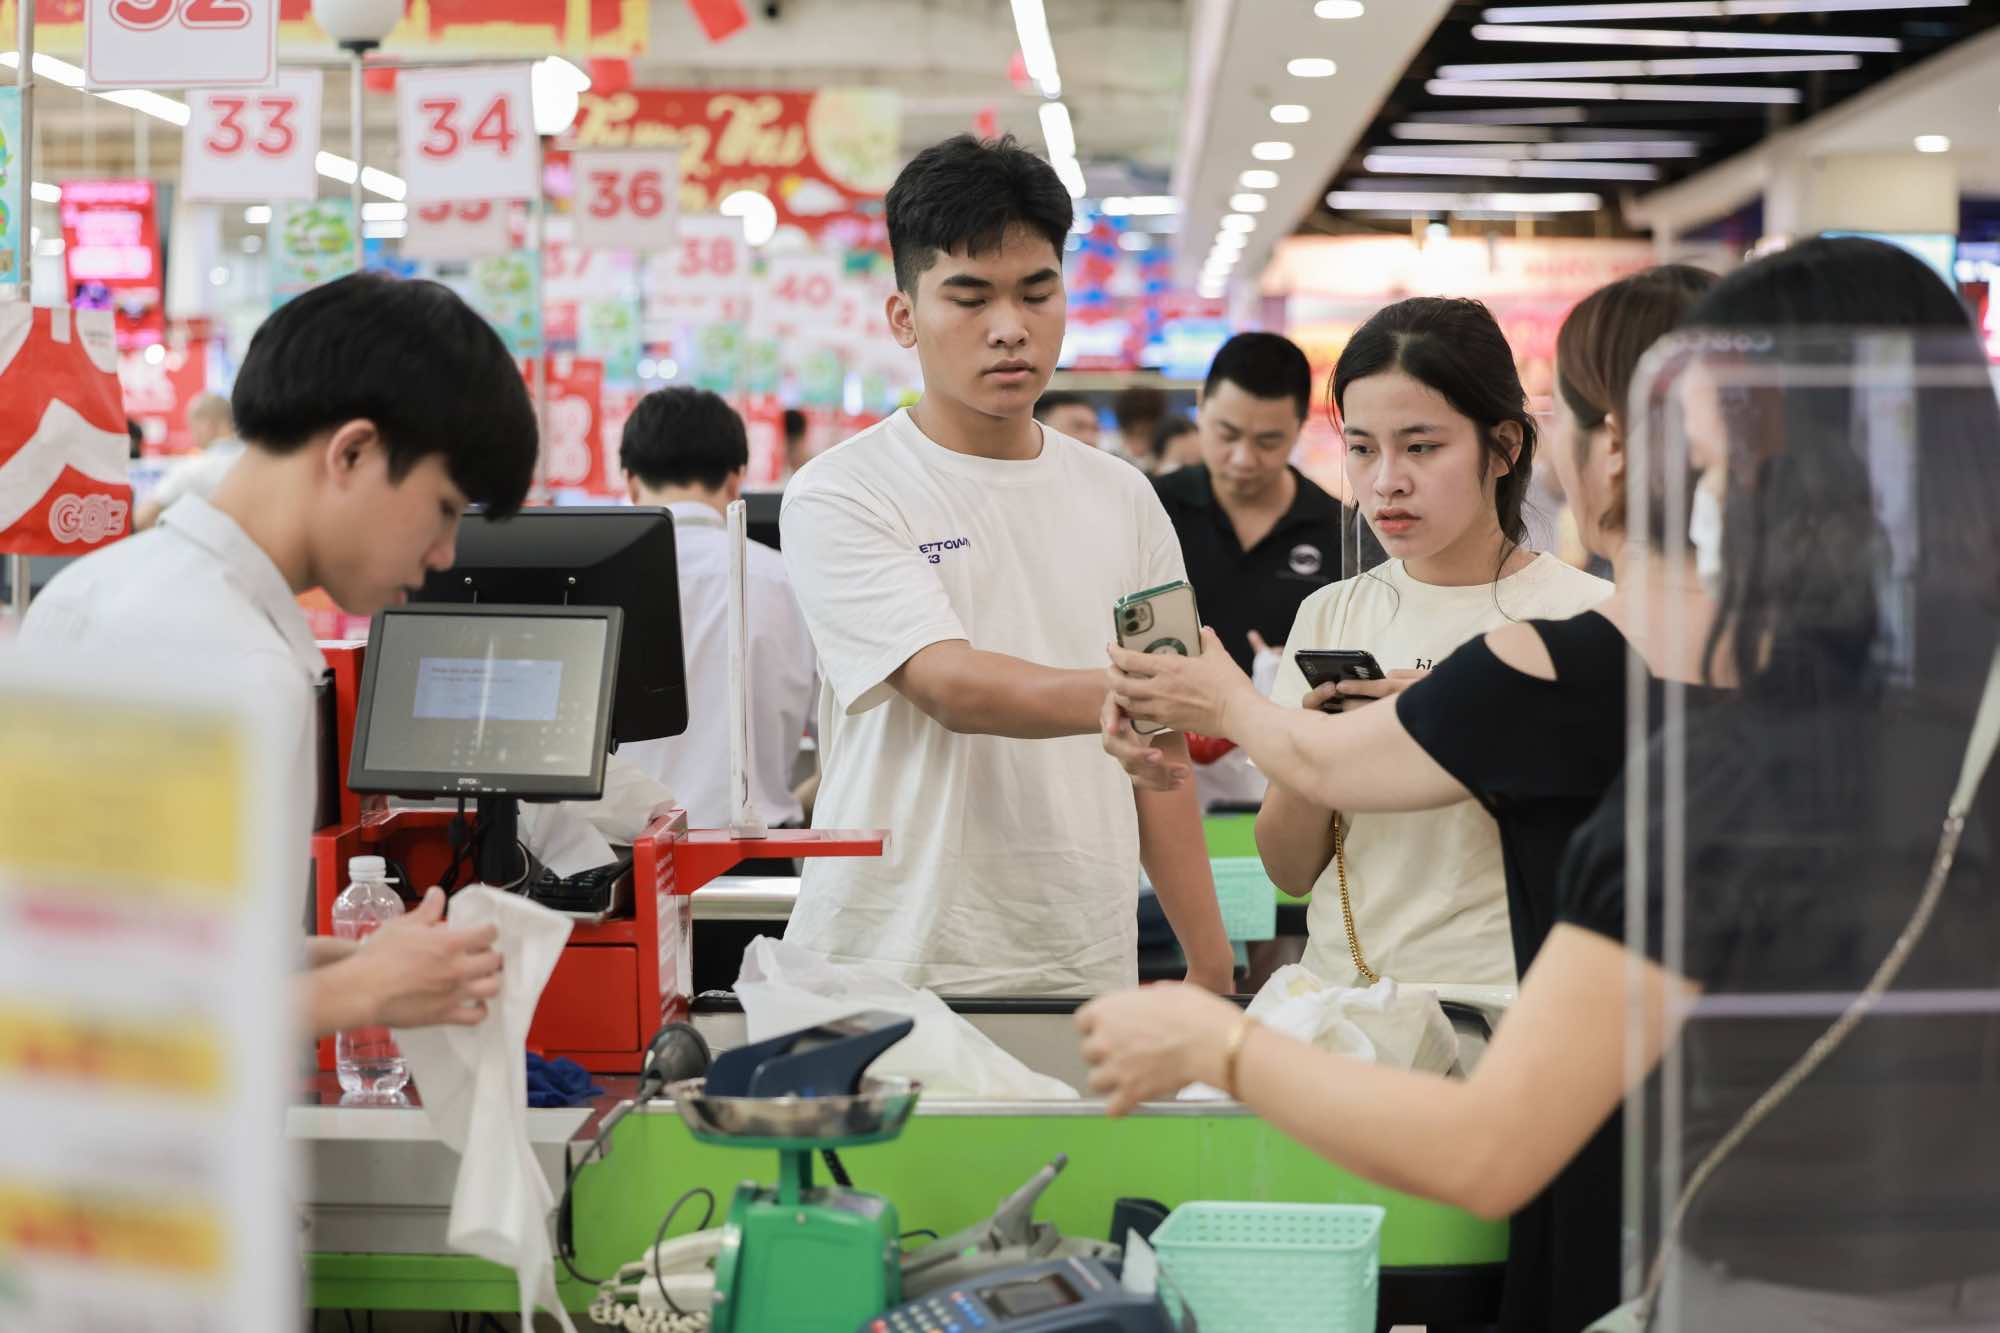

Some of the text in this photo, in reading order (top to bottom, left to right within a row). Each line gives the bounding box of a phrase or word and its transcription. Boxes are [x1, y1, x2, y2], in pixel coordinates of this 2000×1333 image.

[207, 97, 298, 155] 33
[420, 96, 516, 158] 34
[588, 169, 665, 220] 36
[676, 236, 737, 277] 38
[774, 272, 833, 306] 40
[927, 554, 941, 564] 3
